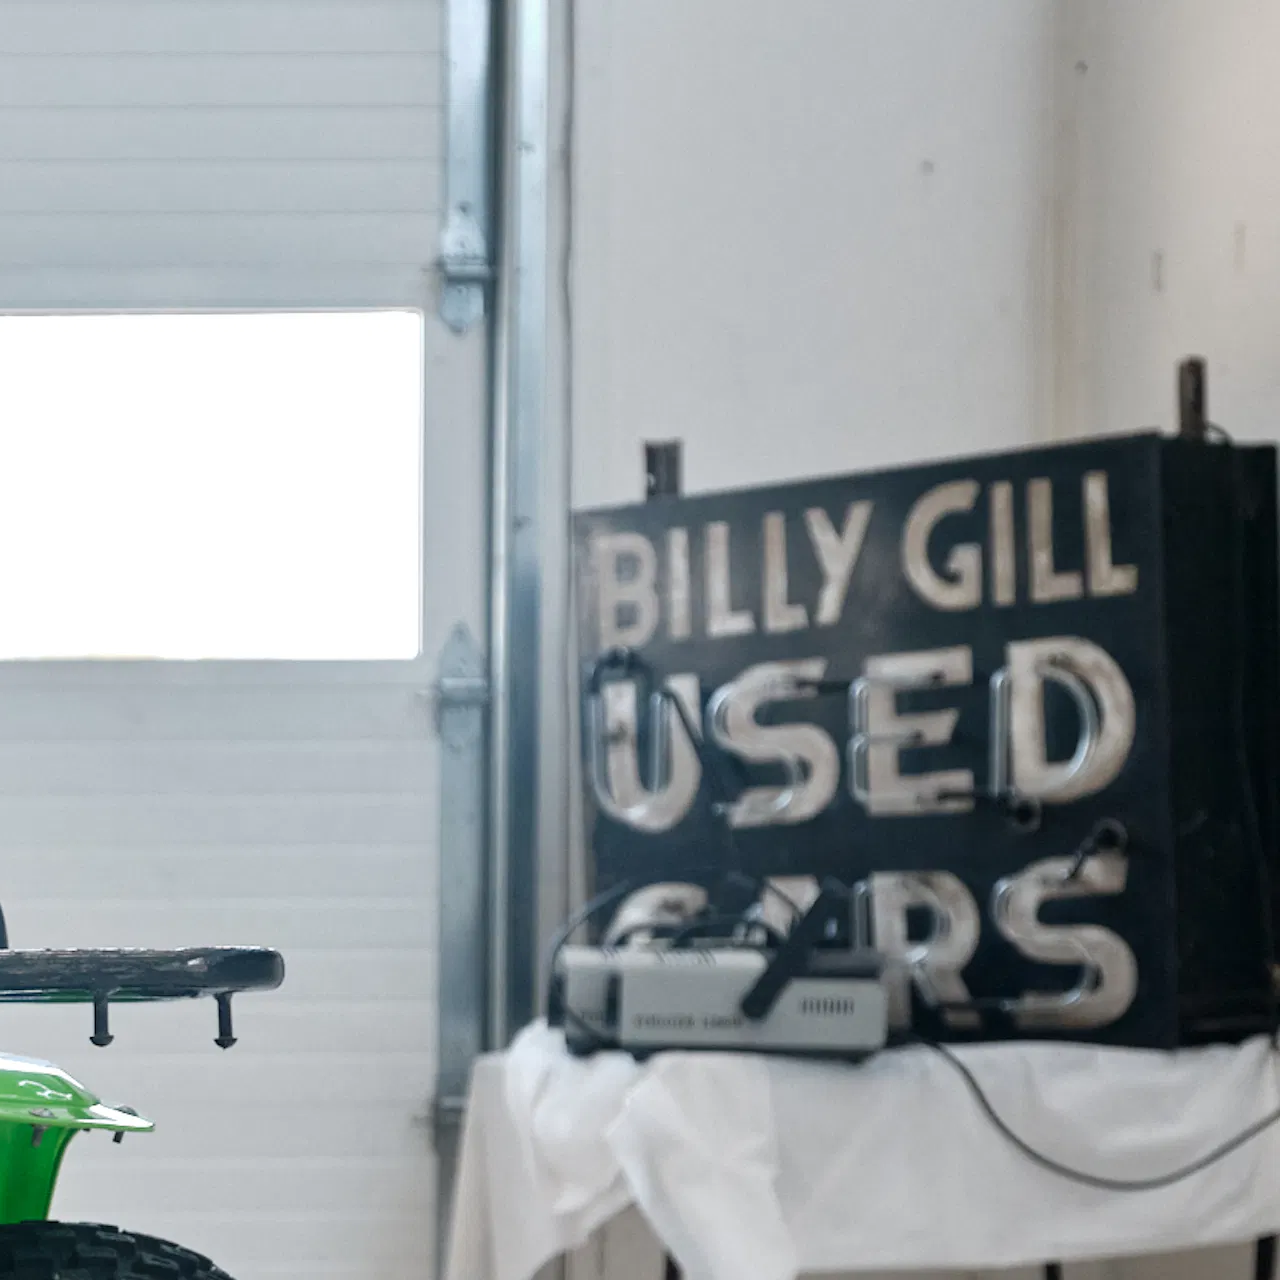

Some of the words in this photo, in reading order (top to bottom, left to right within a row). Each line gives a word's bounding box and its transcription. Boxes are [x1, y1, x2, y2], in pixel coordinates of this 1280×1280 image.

[595, 500, 874, 649] BILLY
[901, 469, 1139, 611] GILL
[587, 635, 1138, 834] USED
[603, 854, 1140, 1031] RS
